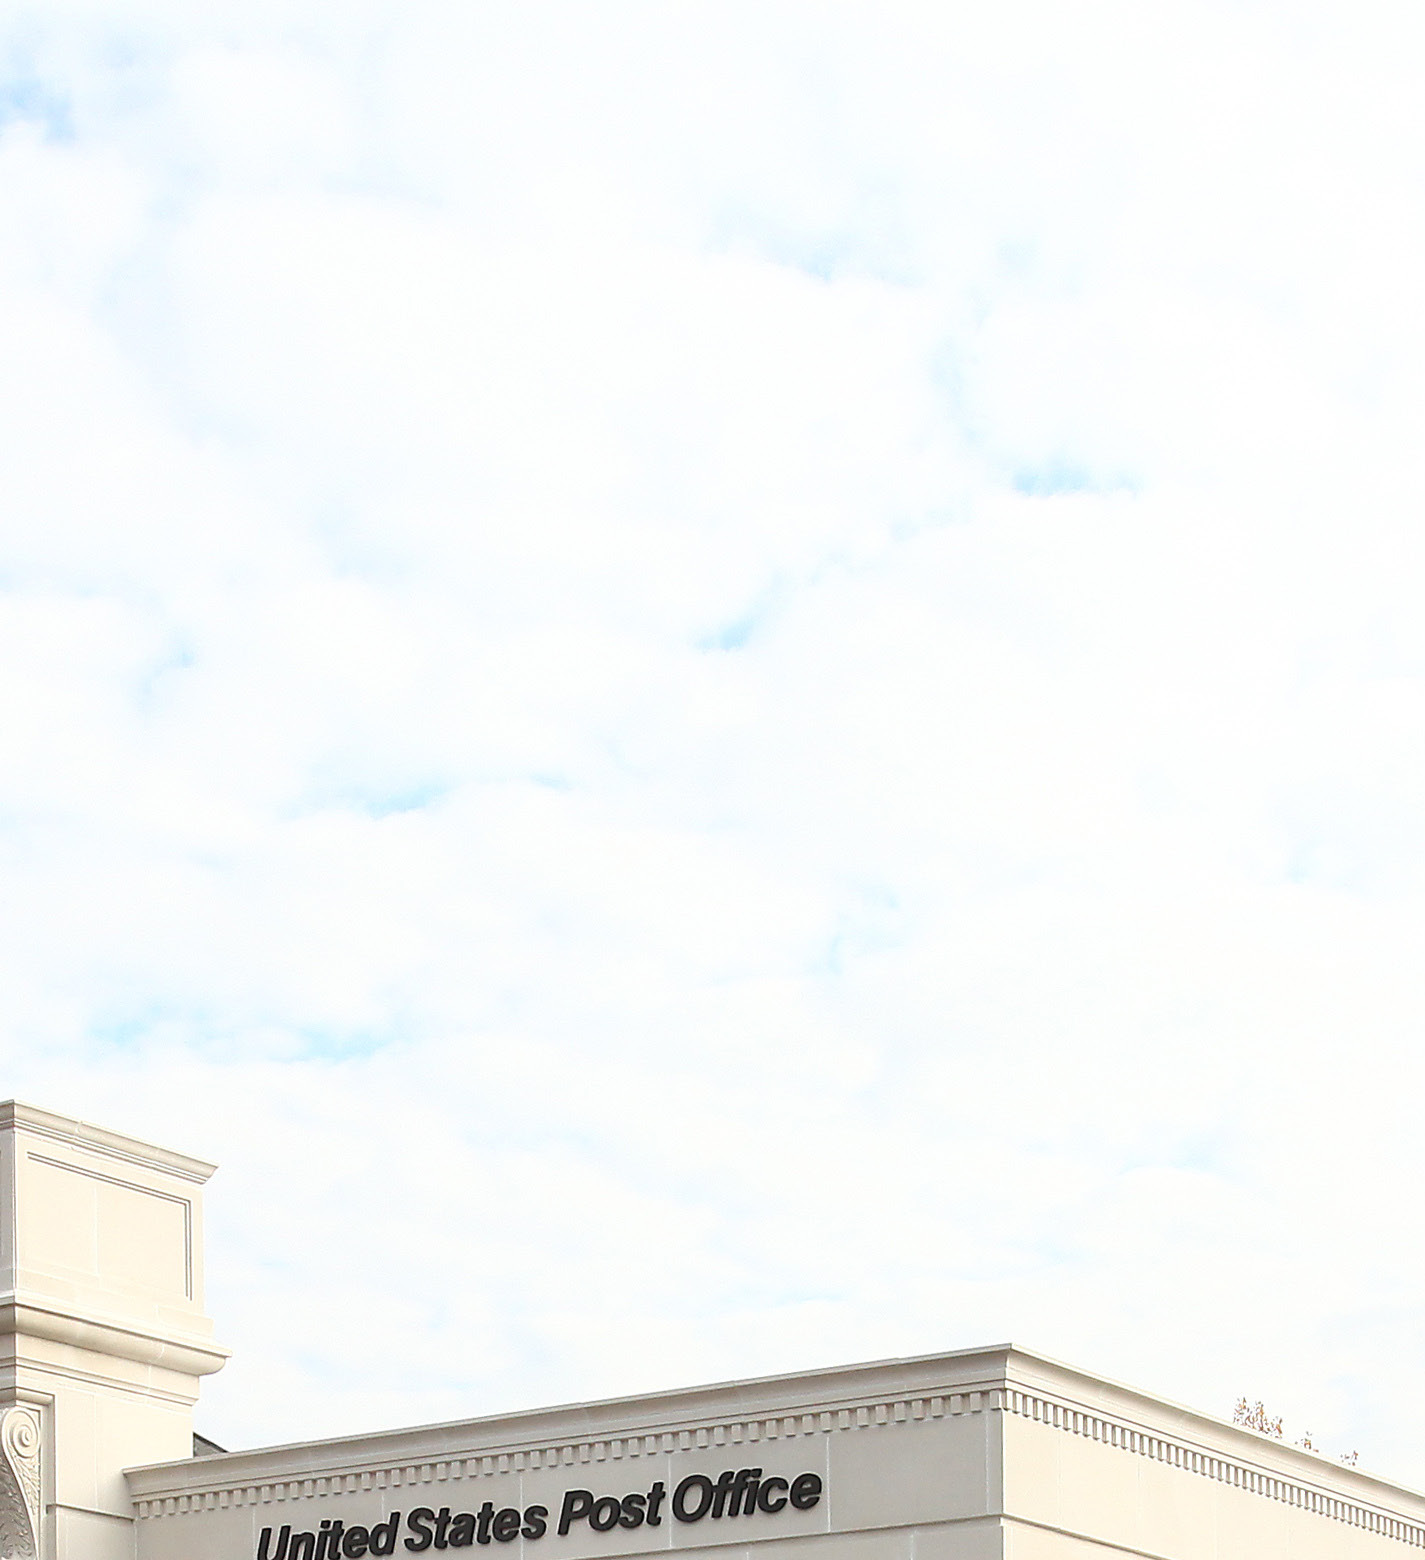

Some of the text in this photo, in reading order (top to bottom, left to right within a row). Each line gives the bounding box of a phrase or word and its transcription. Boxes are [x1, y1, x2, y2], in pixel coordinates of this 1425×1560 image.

[404, 1502, 548, 1552] States
[558, 1482, 666, 1535] Post
[672, 1468, 823, 1523] Office
